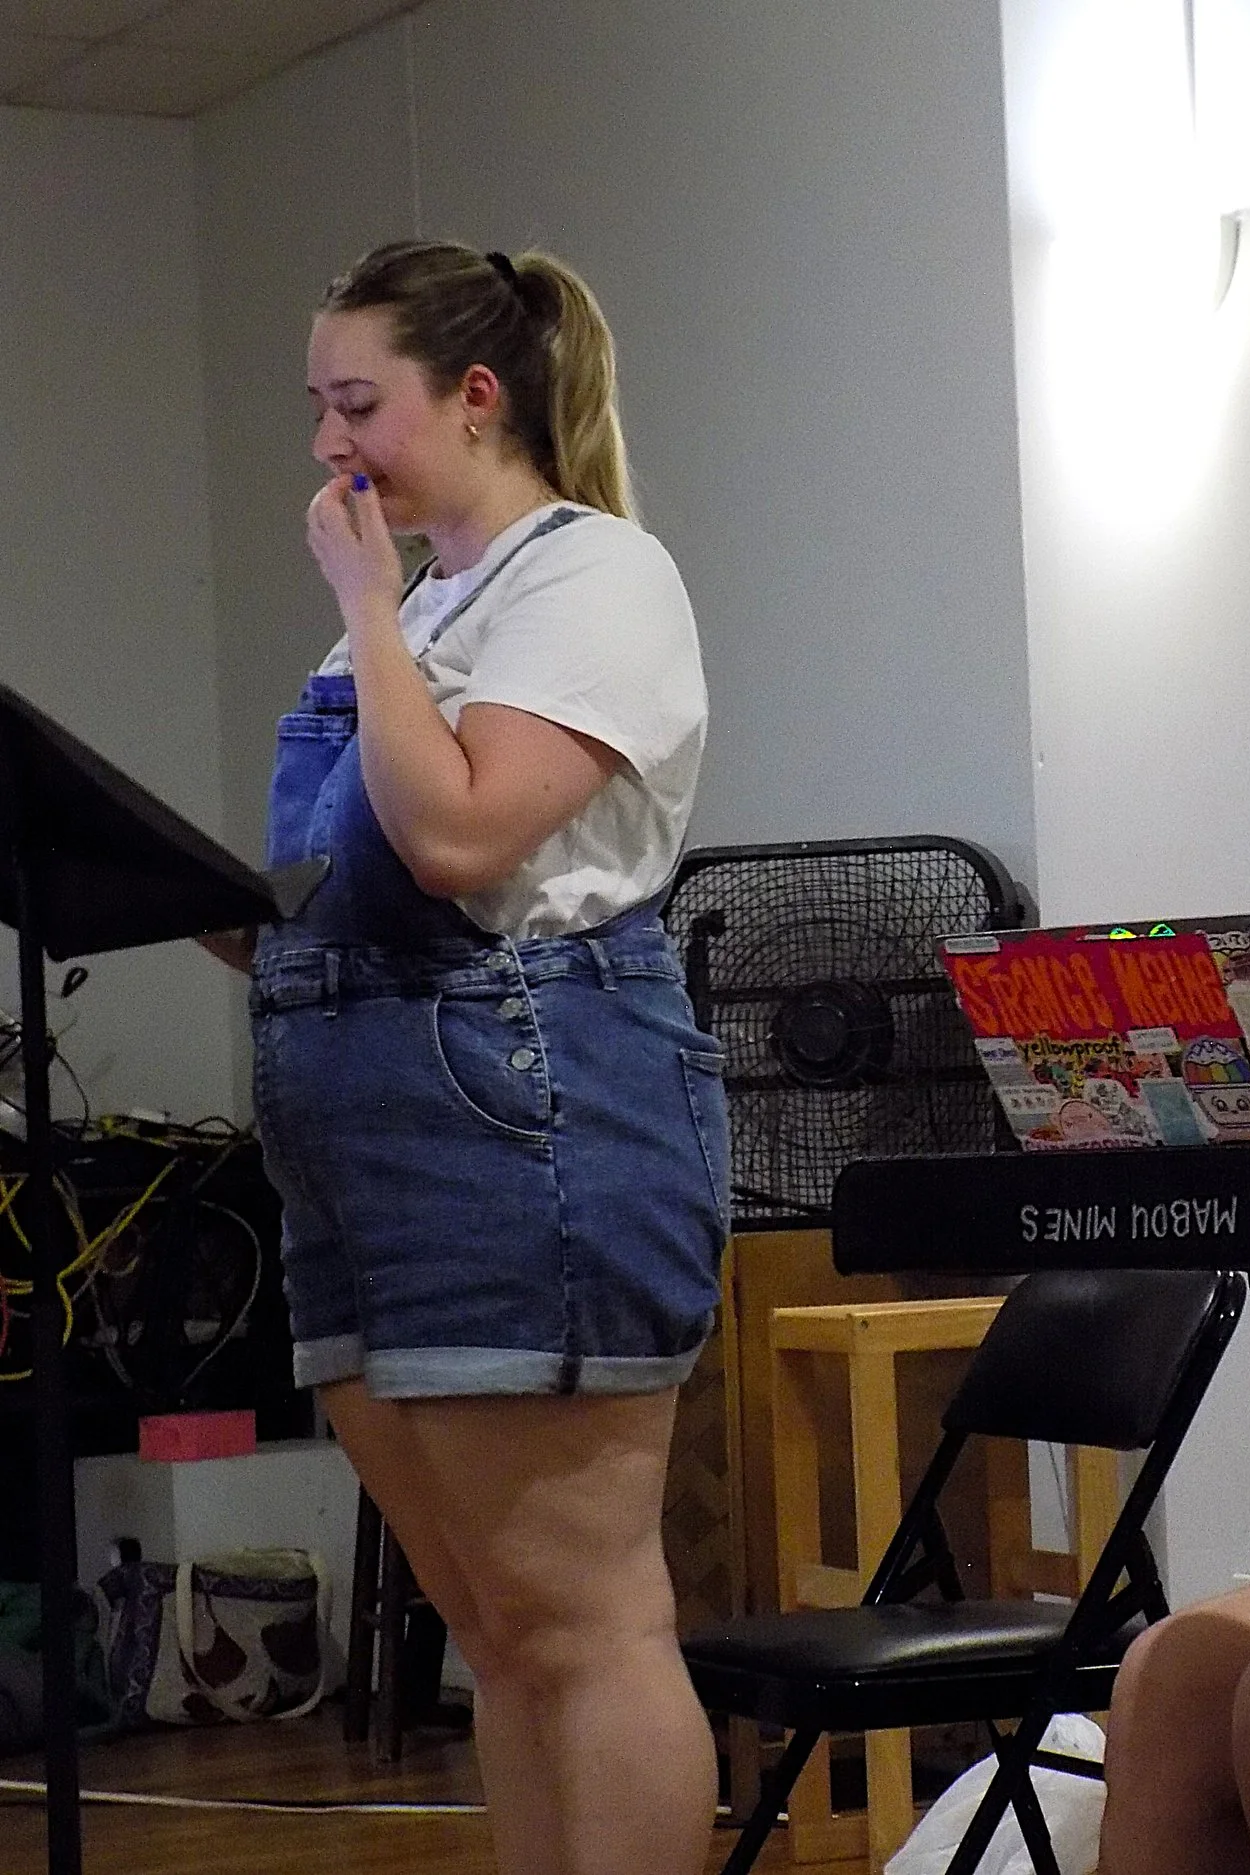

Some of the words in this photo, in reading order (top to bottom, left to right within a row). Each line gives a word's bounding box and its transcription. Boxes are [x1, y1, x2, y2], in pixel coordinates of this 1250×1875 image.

[1018, 1036, 1121, 1064] yellowproof
[1020, 1204, 1116, 1242] MINES
[1131, 1195, 1237, 1239] MABOU
